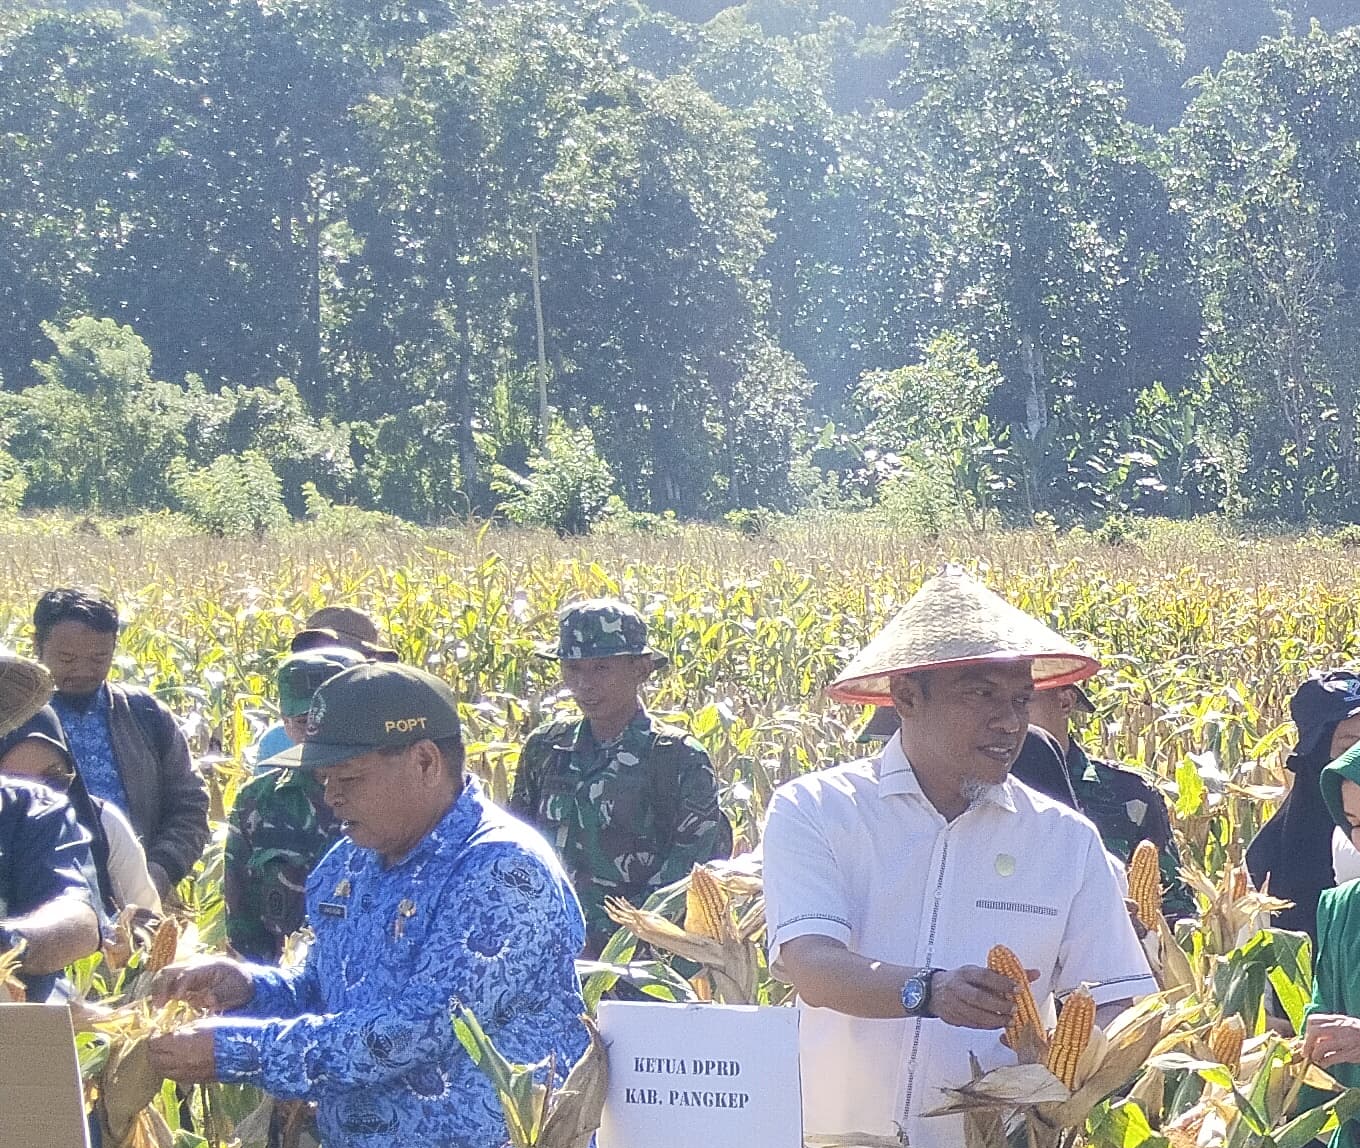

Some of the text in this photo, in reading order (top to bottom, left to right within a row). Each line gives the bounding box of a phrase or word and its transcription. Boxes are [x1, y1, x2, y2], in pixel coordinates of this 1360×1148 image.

[385, 717, 427, 732] POPT
[634, 1057, 740, 1076] KETUA DPRD
[625, 1088, 749, 1108] KAB. PANGKEP
